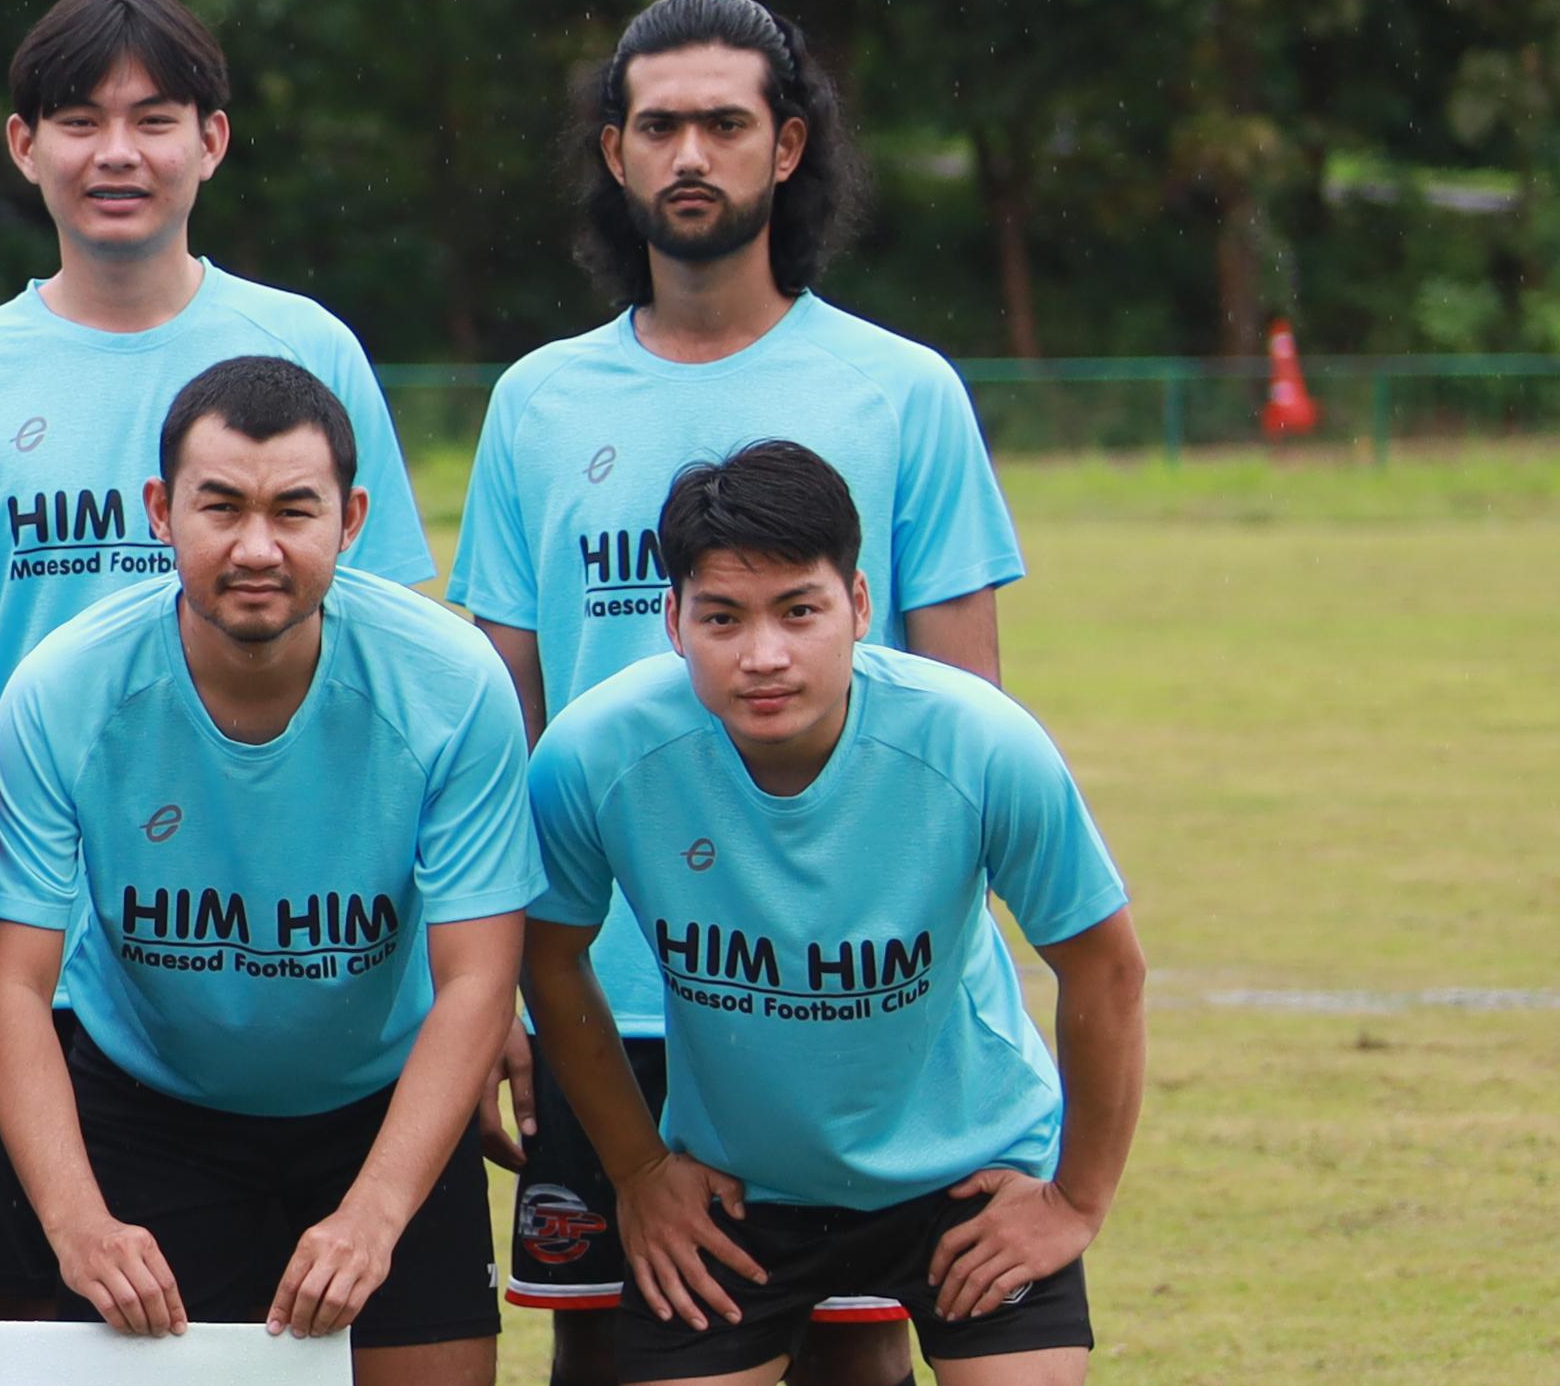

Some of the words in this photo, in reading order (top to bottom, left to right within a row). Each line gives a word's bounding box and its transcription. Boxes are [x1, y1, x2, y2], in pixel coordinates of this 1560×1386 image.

[8, 489, 125, 547] HIM
[10, 553, 101, 580] Maesod
[110, 552, 177, 574] Footb
[122, 885, 250, 944] HIM
[277, 892, 398, 948] HIM
[121, 944, 224, 972] Maesod
[234, 954, 338, 980] Football
[346, 939, 397, 975] Club
[656, 919, 780, 987] HIM
[808, 931, 931, 991] HIM
[764, 997, 869, 1021] Football
[881, 978, 929, 1012] Club
